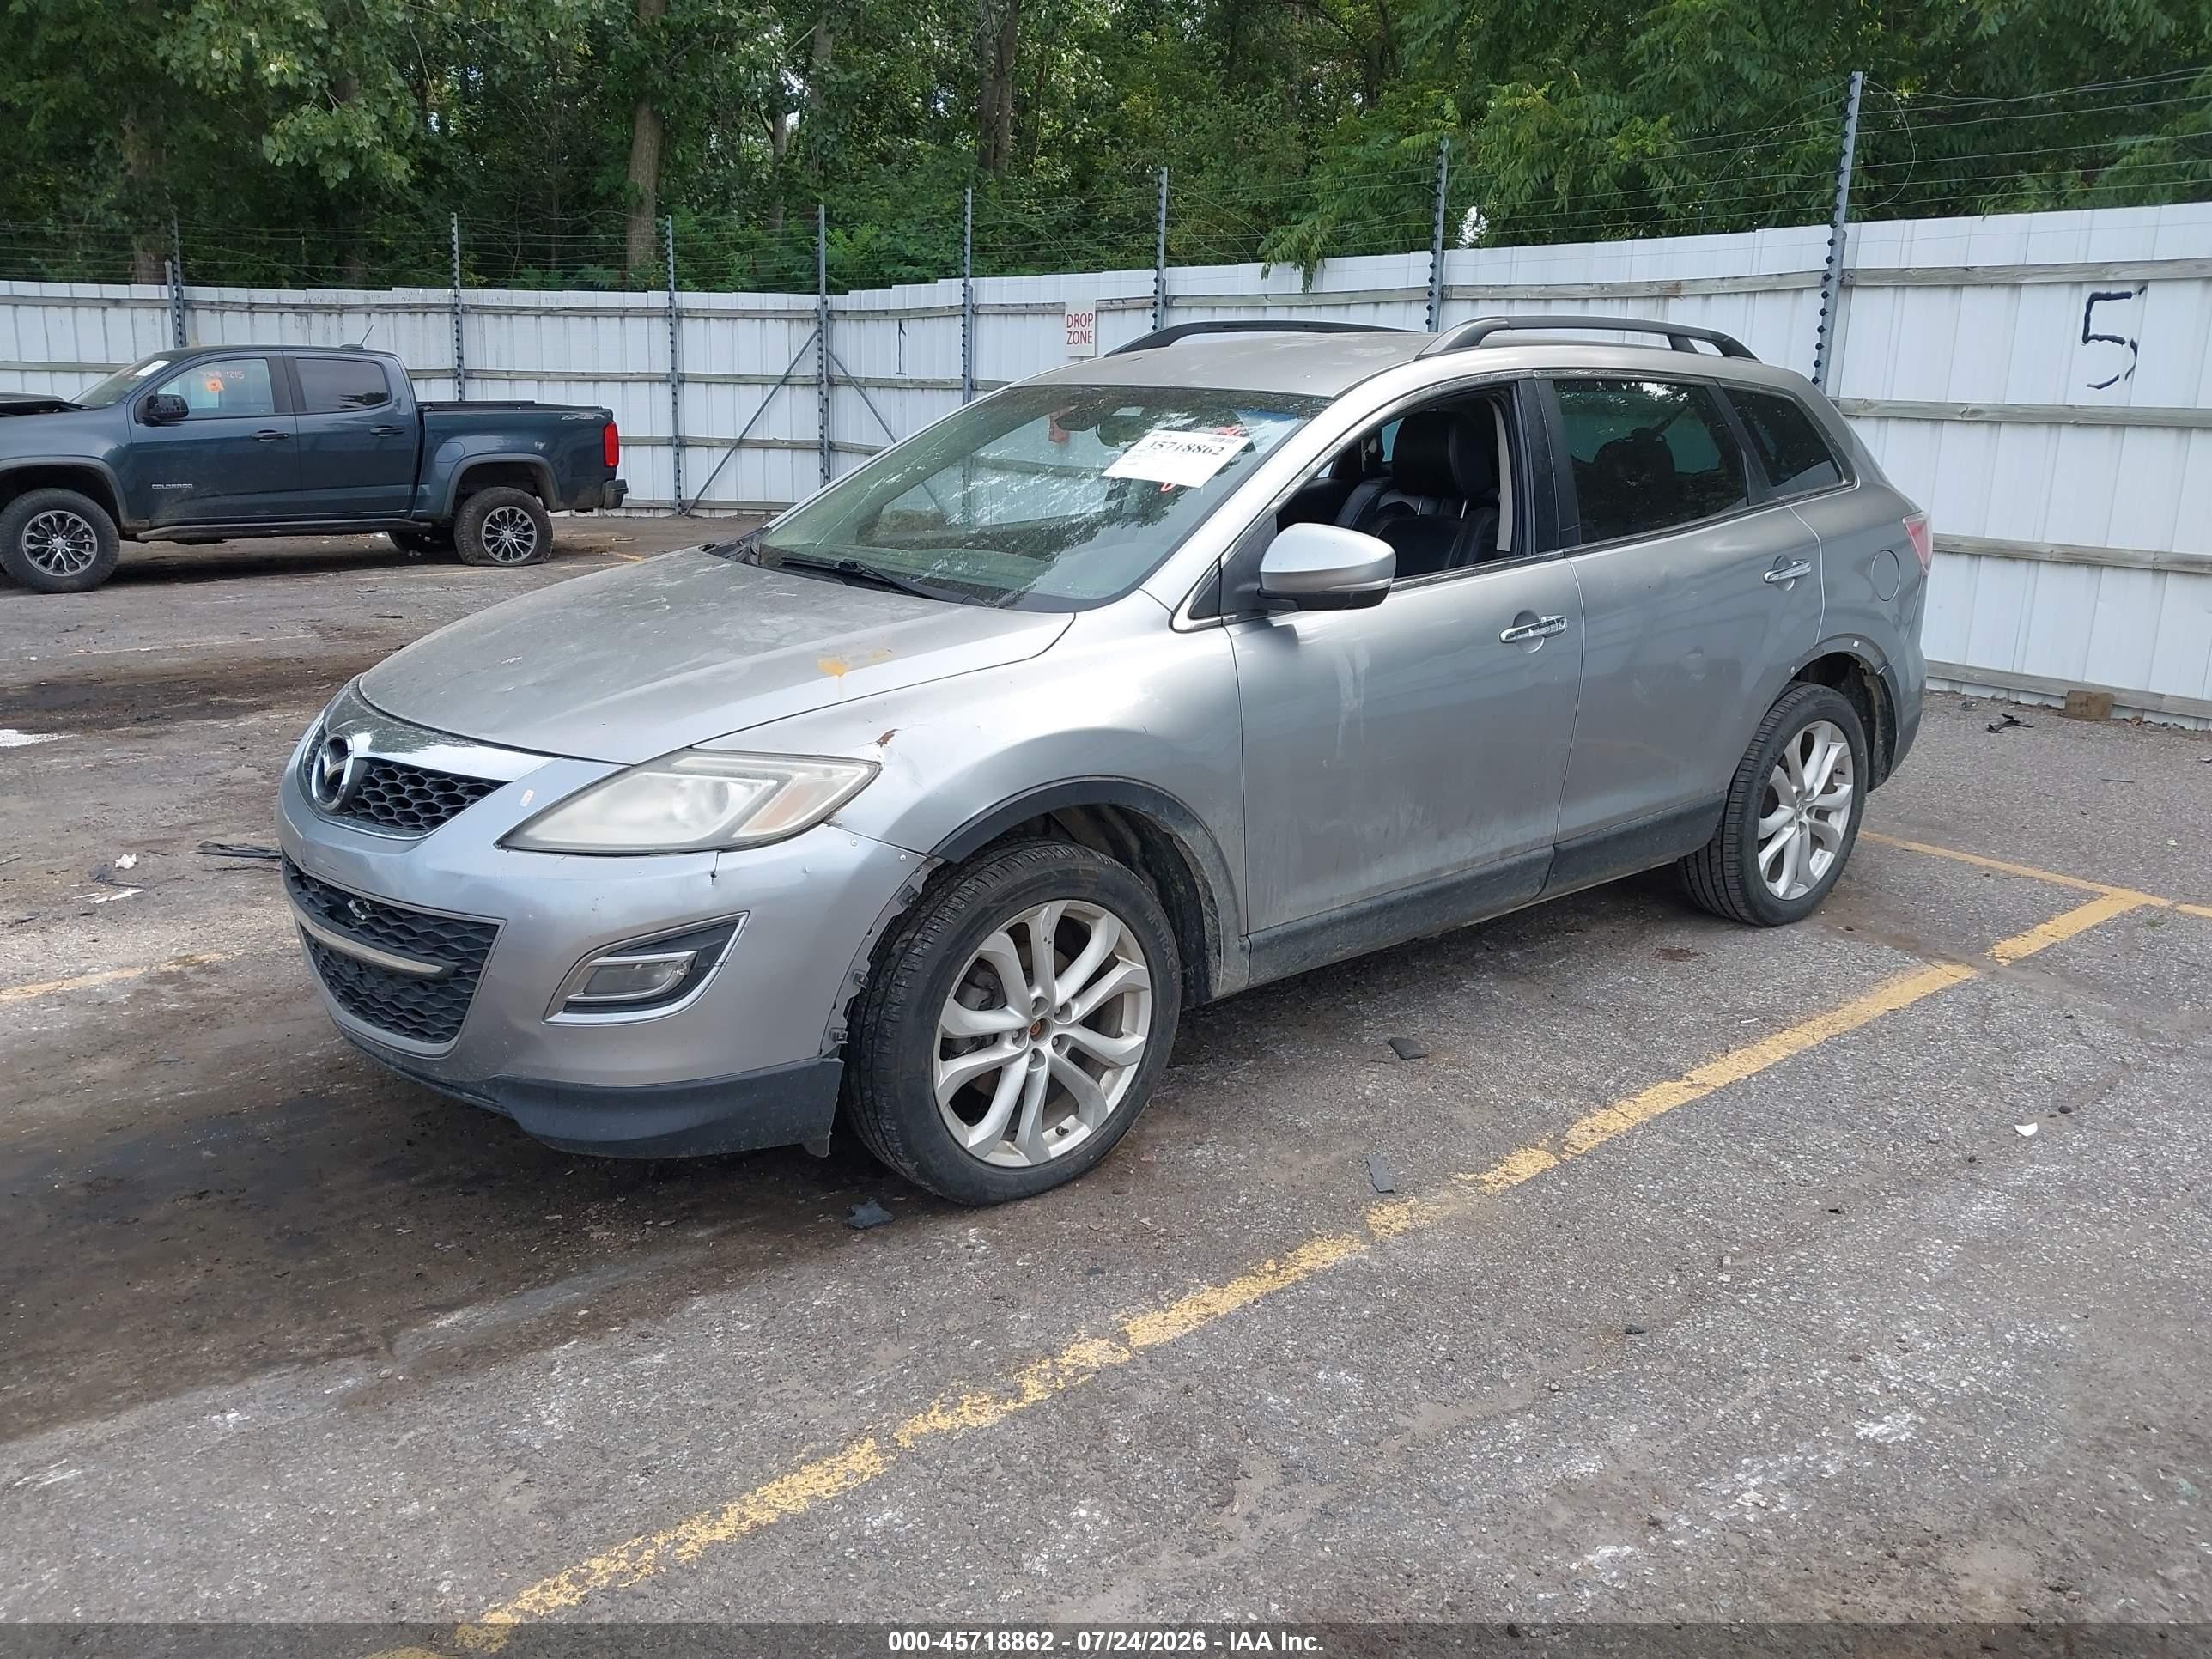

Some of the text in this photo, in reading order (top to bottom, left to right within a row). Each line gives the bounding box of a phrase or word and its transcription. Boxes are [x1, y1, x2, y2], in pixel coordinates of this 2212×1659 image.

[1066, 313, 1094, 328] DROP
[1066, 330, 1093, 344] ZONE
[2082, 286, 2146, 389] 5
